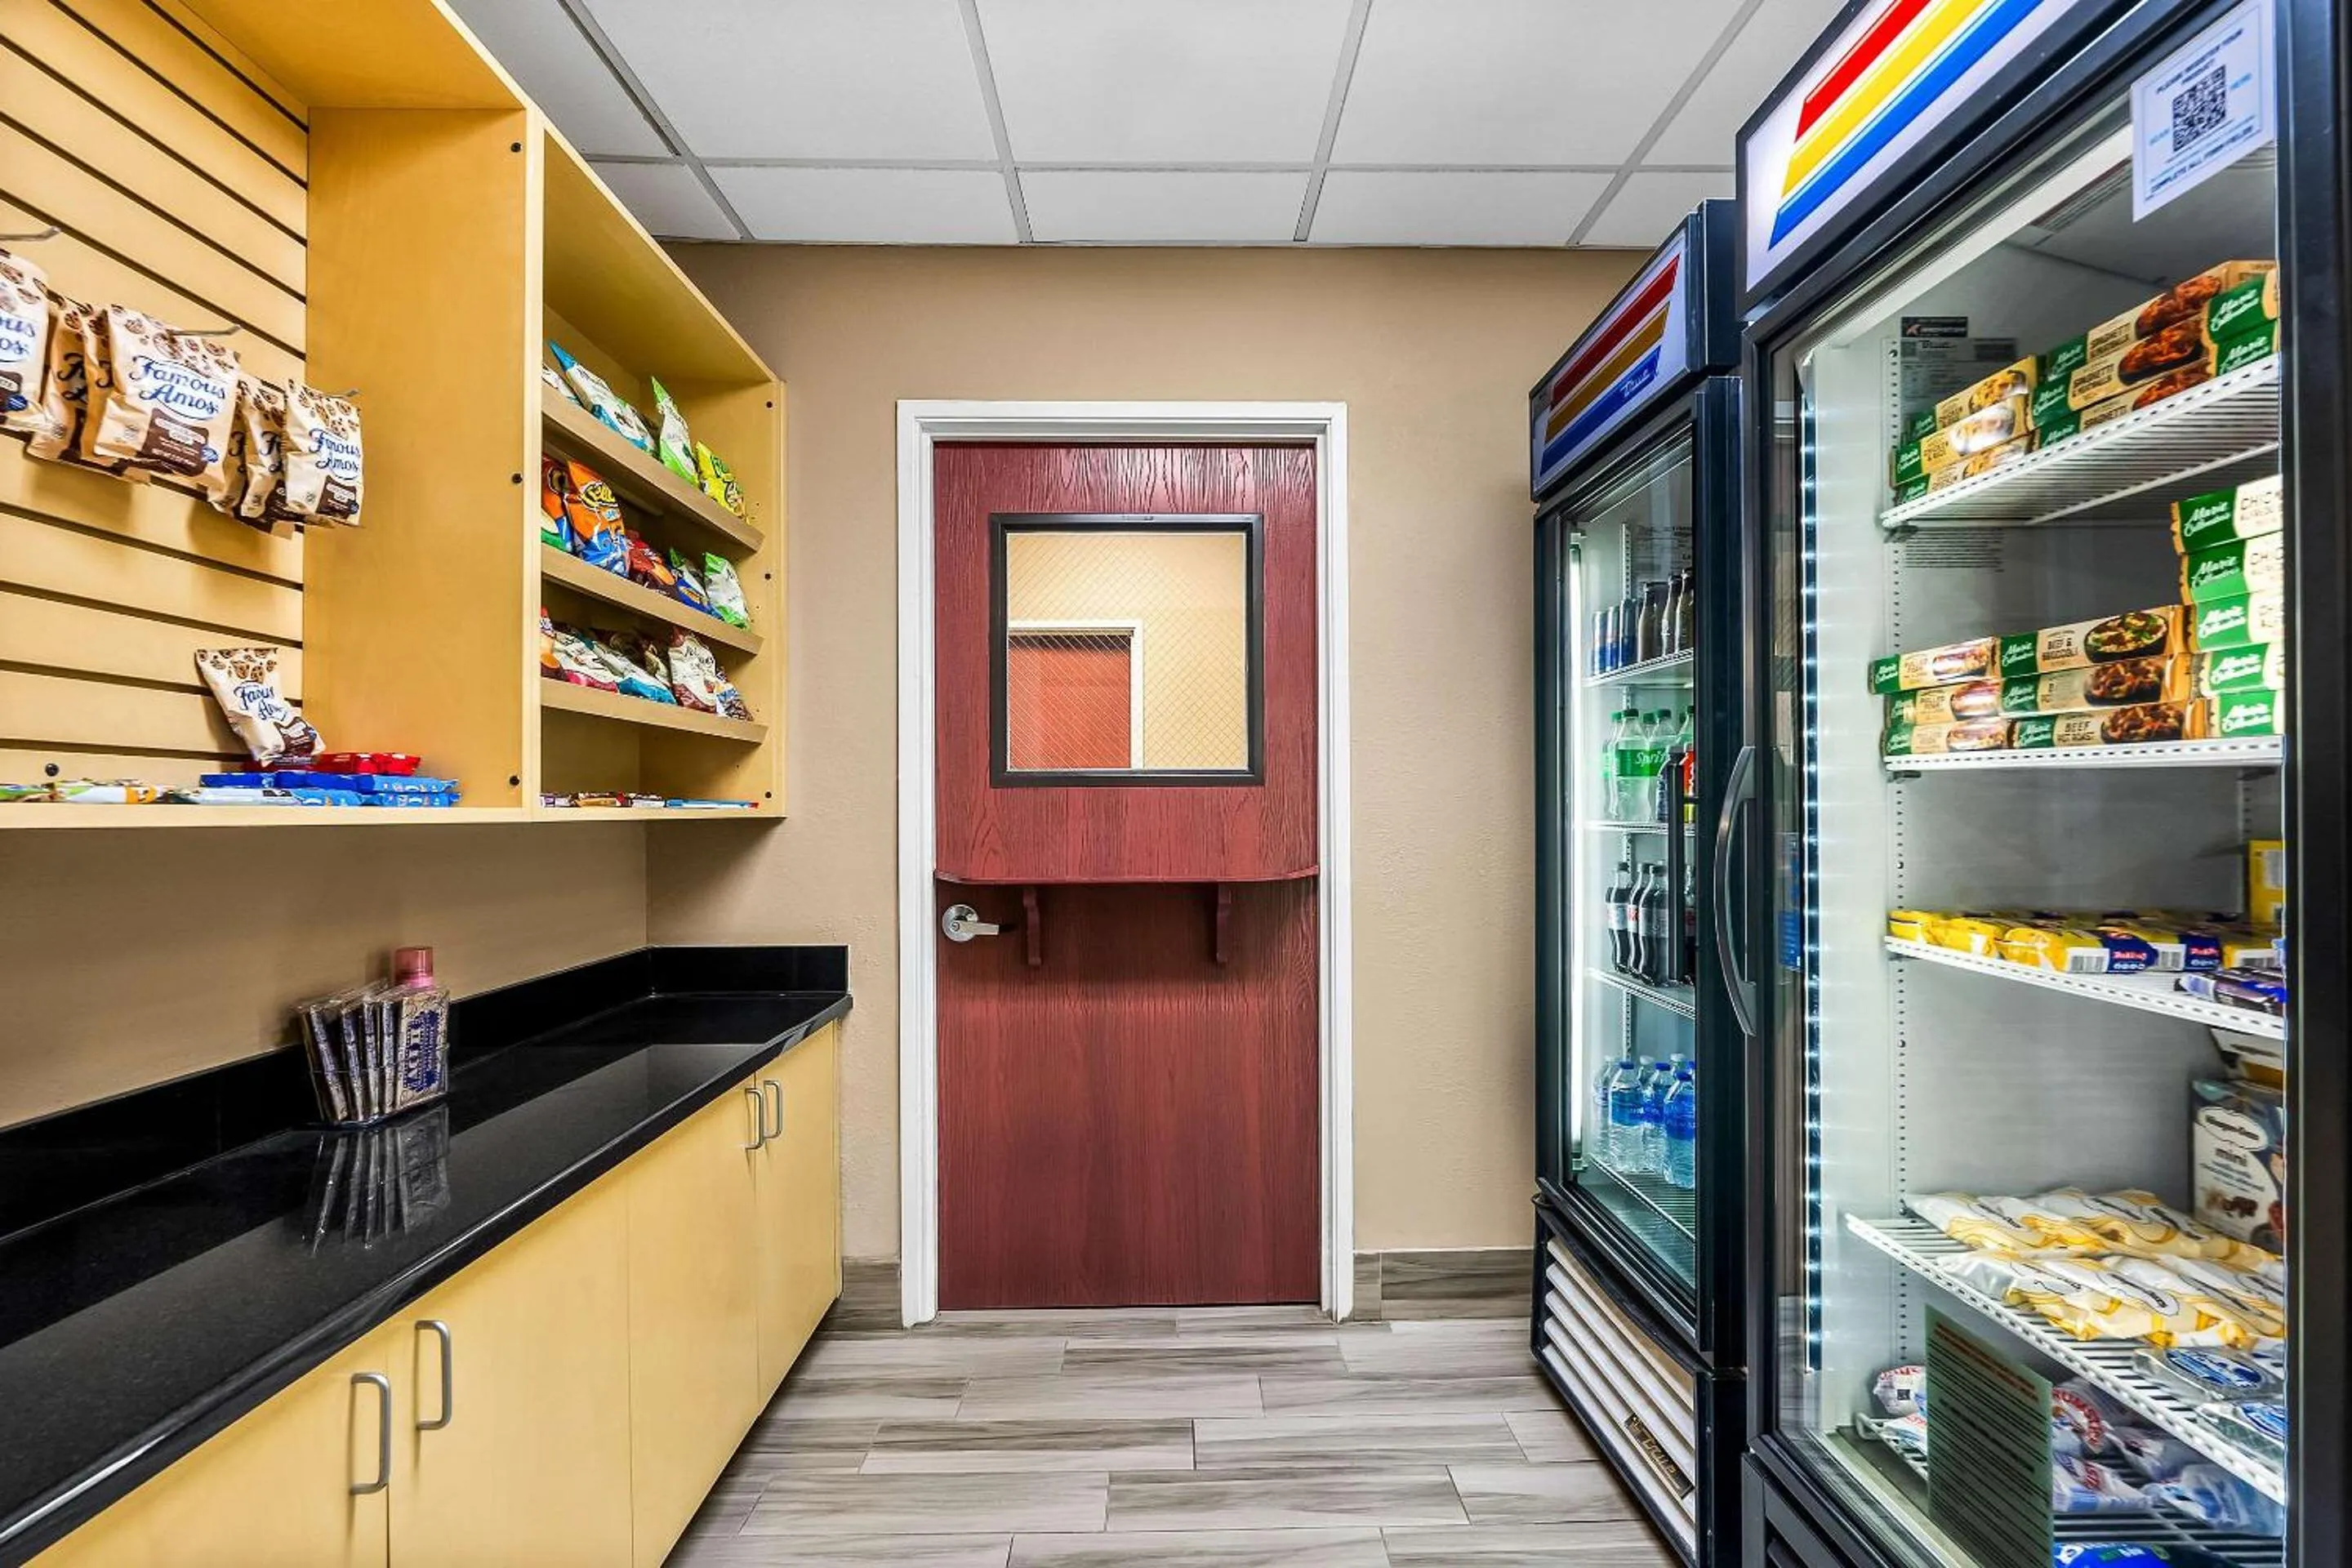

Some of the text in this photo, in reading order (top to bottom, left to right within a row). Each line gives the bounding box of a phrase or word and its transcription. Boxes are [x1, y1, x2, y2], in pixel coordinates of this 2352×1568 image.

[129, 355, 225, 399] Famous
[139, 384, 220, 414] Amos
[1635, 751, 1667, 768] Sprit
